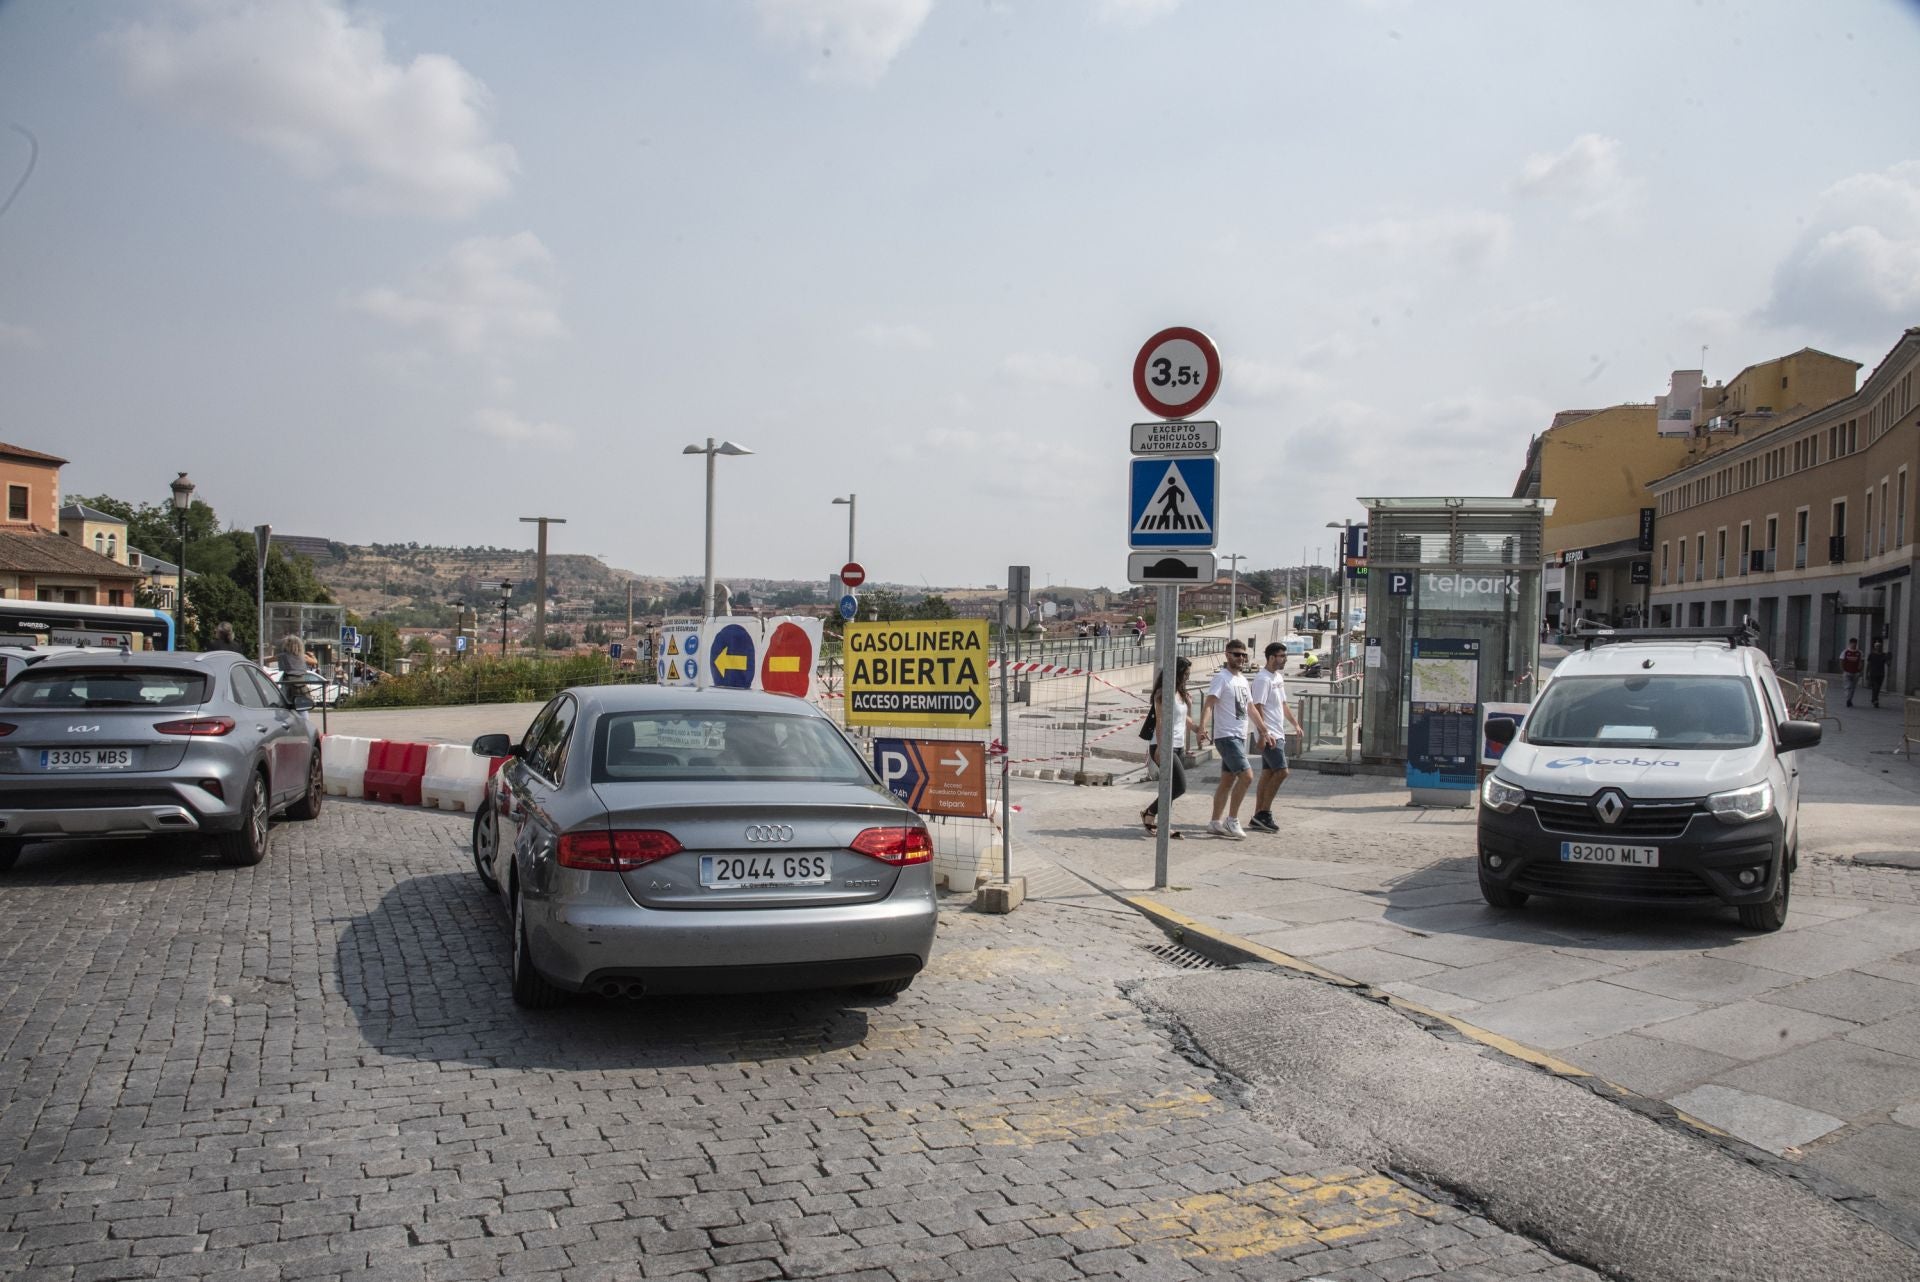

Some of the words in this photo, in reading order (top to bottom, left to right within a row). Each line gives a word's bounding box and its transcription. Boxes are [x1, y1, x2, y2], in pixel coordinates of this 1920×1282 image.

[1151, 357, 1200, 388] 3,5t
[1152, 425, 1196, 434] EXCEPTO
[1148, 433, 1200, 442] VEHÍCULOS
[1140, 441, 1208, 450] AUTORIZADOS
[1393, 575, 1406, 593] P
[1427, 573, 1520, 598] telpark
[53, 636, 72, 645] Madrid
[458, 638, 463, 649] P
[850, 630, 981, 652] GASOLINERA
[852, 657, 979, 685] ABIERTA
[854, 694, 899, 709] ACCESO
[902, 695, 975, 710] PERMITIDO
[67, 725, 100, 733] KIA
[51, 751, 92, 765] 3305
[96, 751, 128, 764] MBS
[1594, 757, 1680, 767] cobra
[882, 751, 908, 790] P
[893, 788, 908, 798] 24h
[1573, 845, 1616, 862] 9200
[1621, 848, 1654, 864] MLT
[717, 857, 775, 880] 2044
[783, 857, 825, 878] GSS
